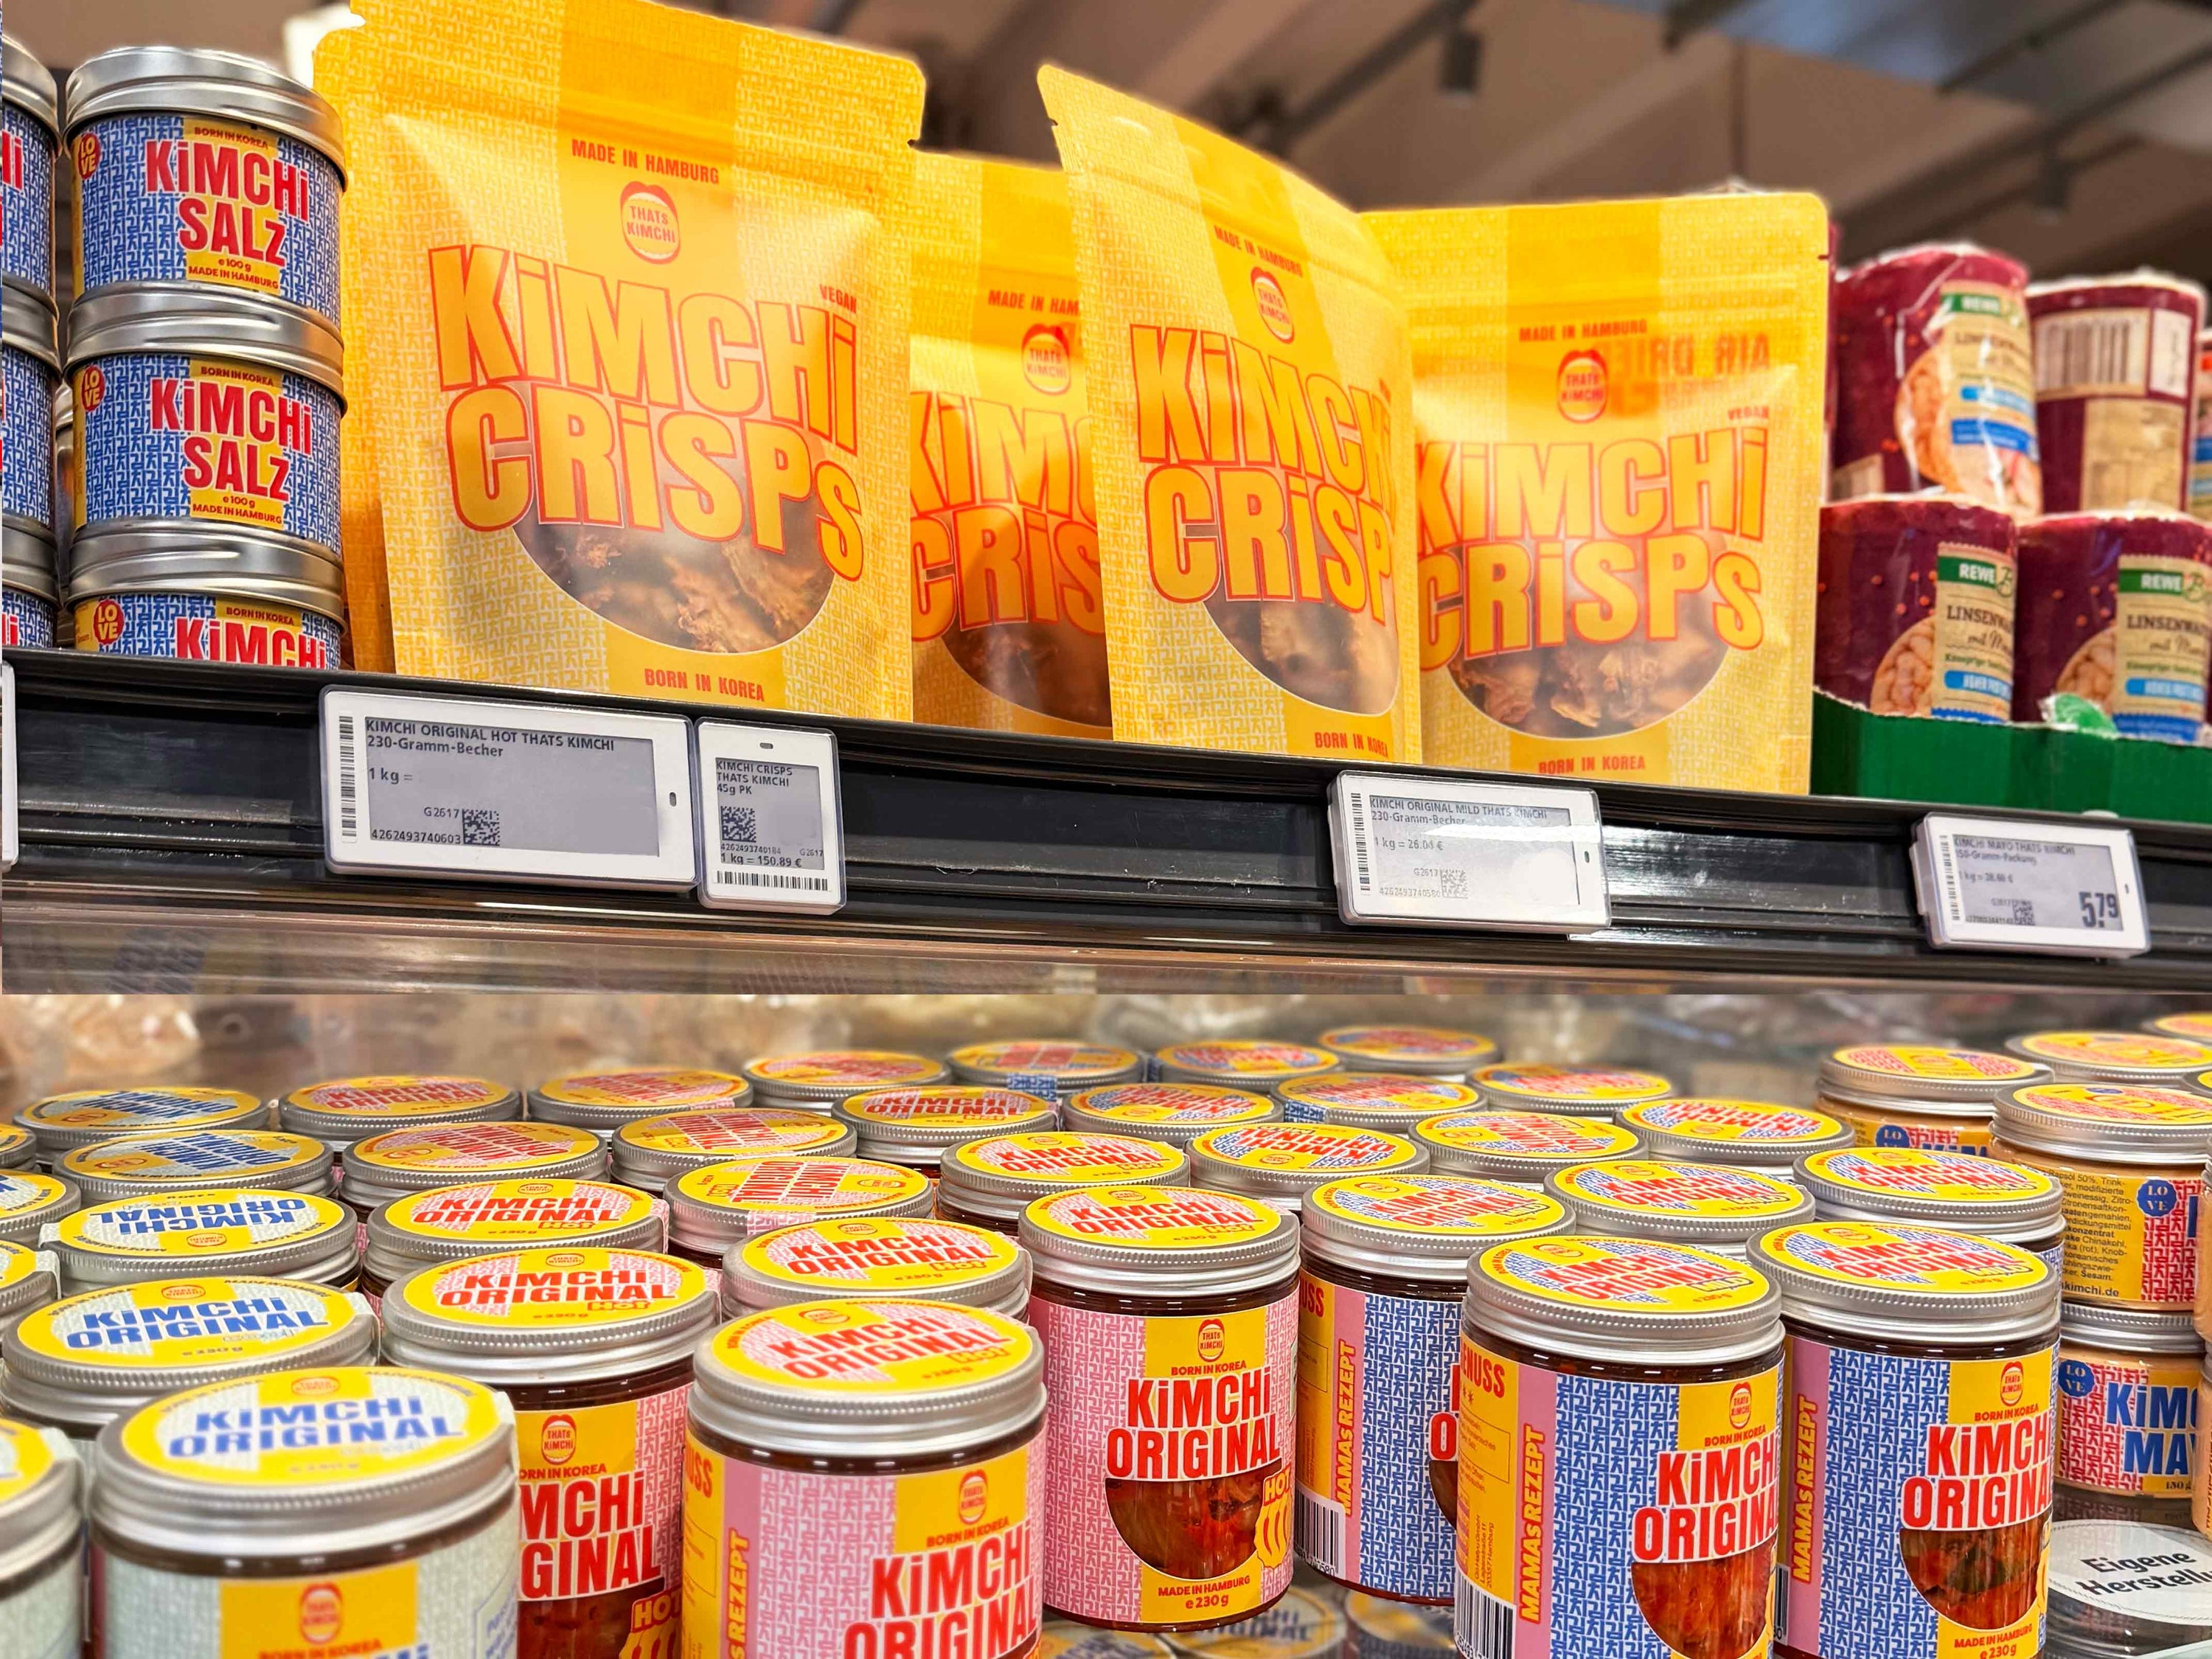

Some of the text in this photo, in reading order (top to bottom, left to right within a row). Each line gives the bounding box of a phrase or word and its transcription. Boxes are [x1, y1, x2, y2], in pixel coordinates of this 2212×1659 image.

[80, 136, 94, 154] LO
[195, 127, 268, 149] BORN IN KOREA
[82, 157, 96, 173] VE
[571, 139, 720, 184] MADE IN HAMBURG
[630, 206, 668, 225] THATS
[178, 199, 285, 266] SALZ
[226, 258, 251, 272] 100 g
[189, 266, 278, 289] MADE IN HAMBURG
[819, 283, 857, 315] VEGAN
[988, 289, 1025, 307] MADE
[1031, 292, 1046, 310] IN
[1519, 326, 1555, 342] MADE
[84, 370, 100, 391] LO
[201, 366, 274, 386] BORN IN KOREA
[85, 390, 101, 406] VE
[184, 437, 289, 501] SALZ
[231, 495, 255, 508] 100 g
[193, 504, 282, 524] MADE IN HAMBURG
[98, 606, 119, 622] LO
[226, 607, 294, 625] BORN IN KOREA
[99, 623, 119, 641] VE
[644, 668, 764, 702] BORN IN KOREA
[366, 720, 614, 751] KIMCHI ORIGINAL HOT THATS KIMCHI
[1315, 732, 1363, 750] BORN IN
[368, 737, 503, 757] 230-Gramm-Becher
[717, 760, 793, 776] KIMCHI CRISPS
[1539, 755, 1645, 774] BORN IN KOREA
[369, 768, 400, 785] 1 kg
[717, 772, 789, 787] THATS KIMCHI
[717, 784, 752, 796] 45g PK
[424, 807, 459, 818] G2617
[1370, 799, 1547, 819] KIMCHI ORIGINAL MILD THATS KIMCHI
[1371, 811, 1465, 825] 230-Gramm-Becher
[1375, 837, 1379, 845] 1
[1382, 837, 1395, 850] kg
[1987, 840, 2013, 851] MAYO
[721, 853, 801, 867] 1 kg 150.89 €
[2147, 1185, 2167, 1196] LO
[2147, 1200, 2168, 1211] VE
[413, 1210, 620, 1222] ORIGINAL
[1071, 1211, 1263, 1234] ORIGINAL
[786, 1246, 999, 1275] ORIGINAL
[1834, 1252, 2024, 1278] ORIGINAL
[1564, 1263, 1742, 1300] ORIGINAL
[440, 1284, 675, 1307] ORIGINAL
[66, 1311, 328, 1349] ORIGINAL
[1203, 1332, 1220, 1340] THATS
[783, 1328, 1012, 1380] ORIGINAL
[1171, 1360, 1246, 1376] BORN IN KOREA
[2066, 1366, 2086, 1377] LO
[2065, 1380, 2086, 1393] VE
[1975, 1403, 2039, 1422] BORN IN KOREA
[168, 1416, 465, 1458] ORIGINAL
[1705, 1425, 1766, 1447] BORN IN KOREA
[1106, 1414, 1282, 1481] ORIGINAL
[2081, 1553, 2197, 1573] Eigene
[1158, 1576, 1251, 1596] MADE IN HAMBURG
[1195, 1594, 1229, 1608] 230 g
[844, 1573, 1037, 1659] ORIGINAL
